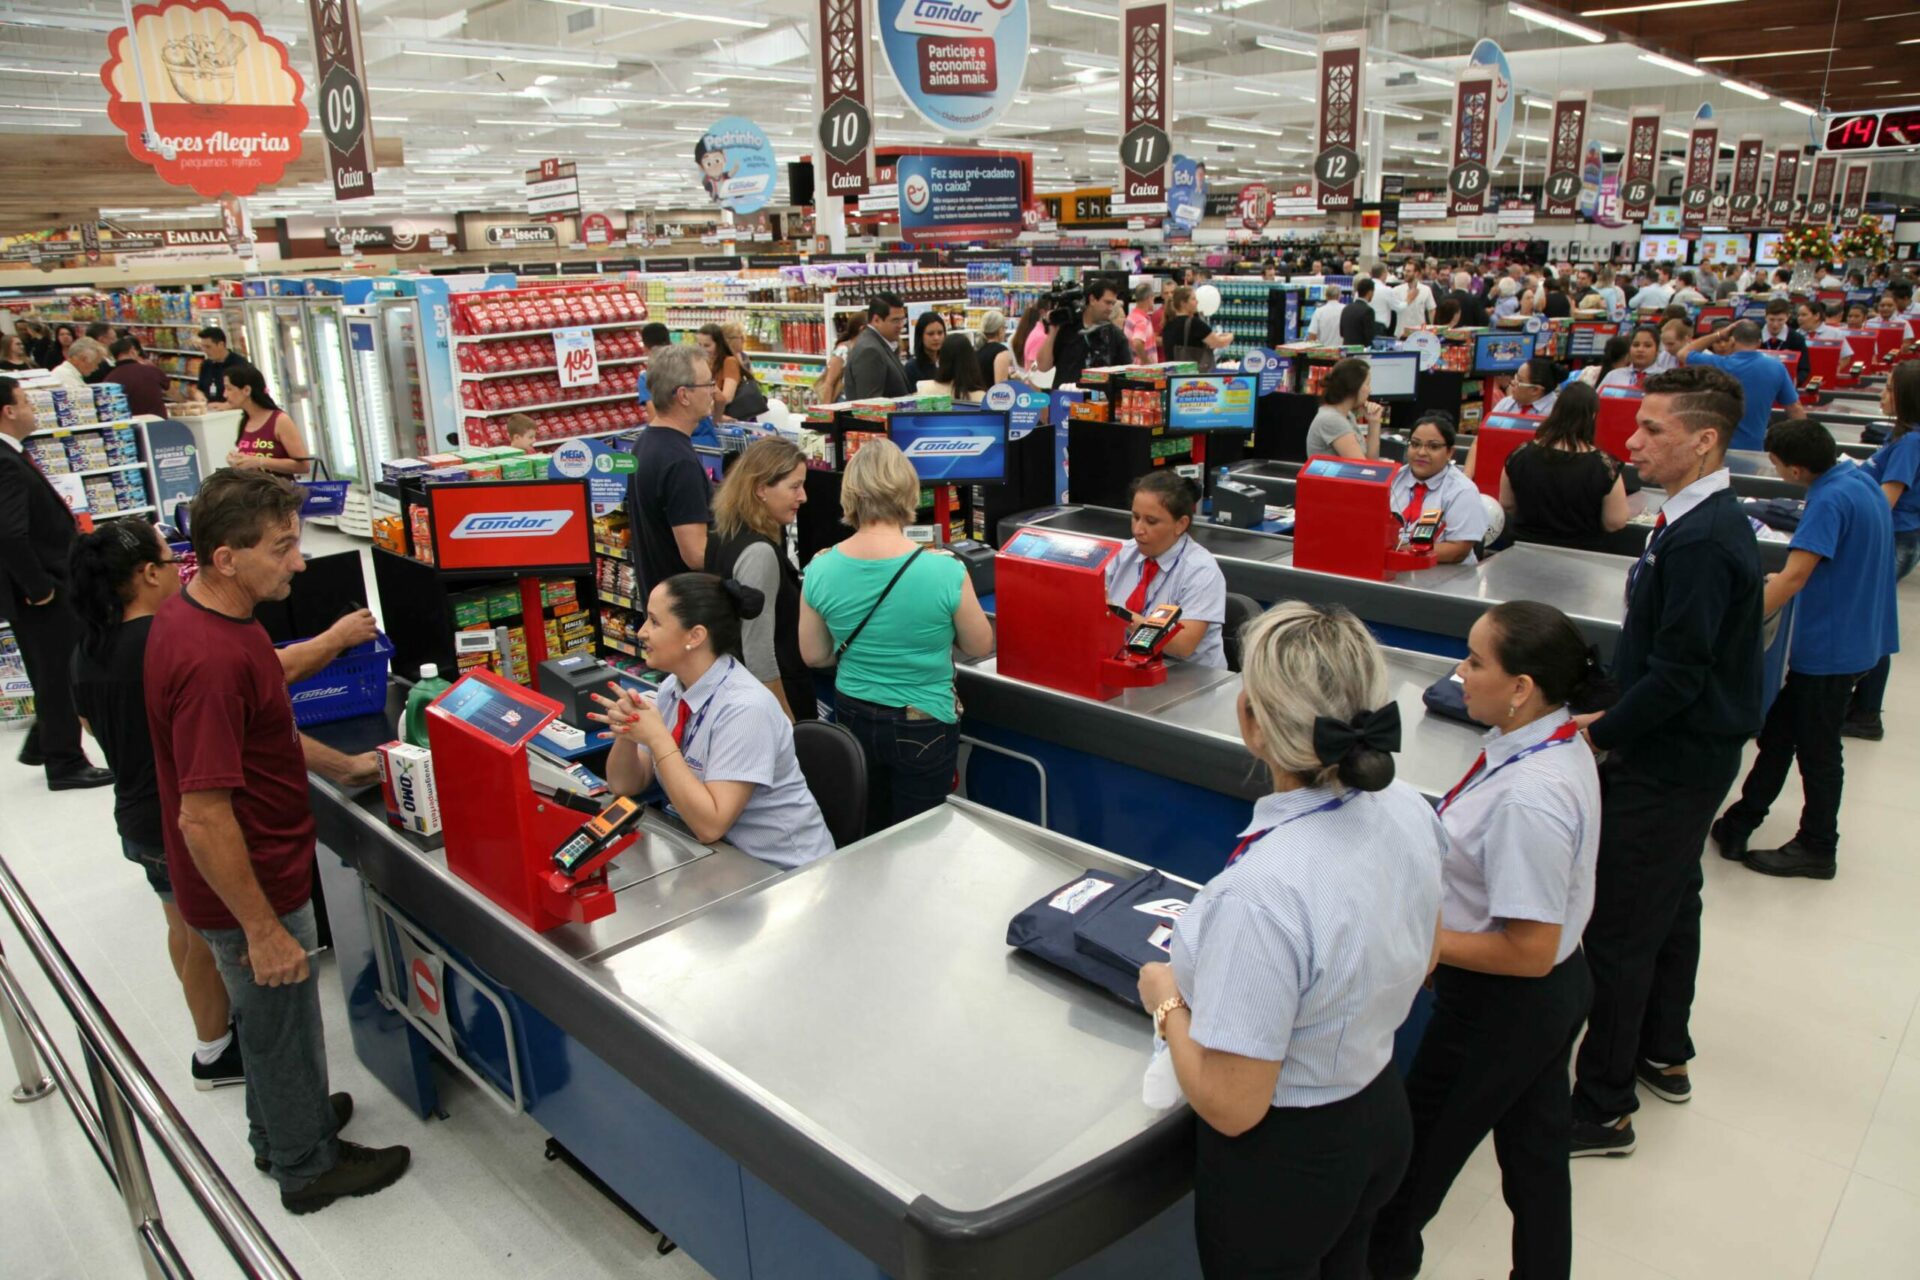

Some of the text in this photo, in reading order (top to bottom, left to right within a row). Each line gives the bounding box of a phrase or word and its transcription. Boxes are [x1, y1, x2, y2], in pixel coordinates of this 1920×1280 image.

[914, 0, 982, 24] Condor
[928, 44, 985, 59] Participe e
[929, 58, 987, 71] economize
[929, 72, 989, 85] ainda mais.
[327, 84, 356, 135] 09
[832, 112, 859, 147] 10
[1842, 119, 1874, 145] 14
[205, 131, 290, 157] Alegrias
[1134, 136, 1155, 163] 11
[880, 168, 891, 180] 10
[931, 166, 1015, 181] Fez seu pré-cadastro
[1325, 155, 1347, 178] 12
[337, 167, 364, 190] Caixa
[832, 172, 862, 189] Caixa
[931, 180, 971, 191] no caixa?
[1174, 170, 1194, 186] Edu
[1458, 170, 1479, 189] 13
[1553, 177, 1572, 194] 14
[1130, 182, 1159, 197] Caixa
[1629, 185, 1646, 200] 15
[1689, 190, 1706, 204] 16
[1322, 193, 1349, 205] Caixa
[1735, 195, 1750, 208] 17
[1773, 200, 1789, 213] 18
[1455, 202, 1479, 213] Caixa
[1550, 206, 1572, 215] Caixa
[1812, 202, 1826, 214] 19
[1843, 207, 1859, 218] 20
[495, 227, 550, 240] Ptisseria
[914, 440, 981, 451] Condor
[560, 449, 586, 458] MEGA
[465, 516, 552, 530] Condor
[567, 636, 587, 648] HALLS
[292, 685, 349, 702] Condor
[400, 774, 417, 813] OMO
